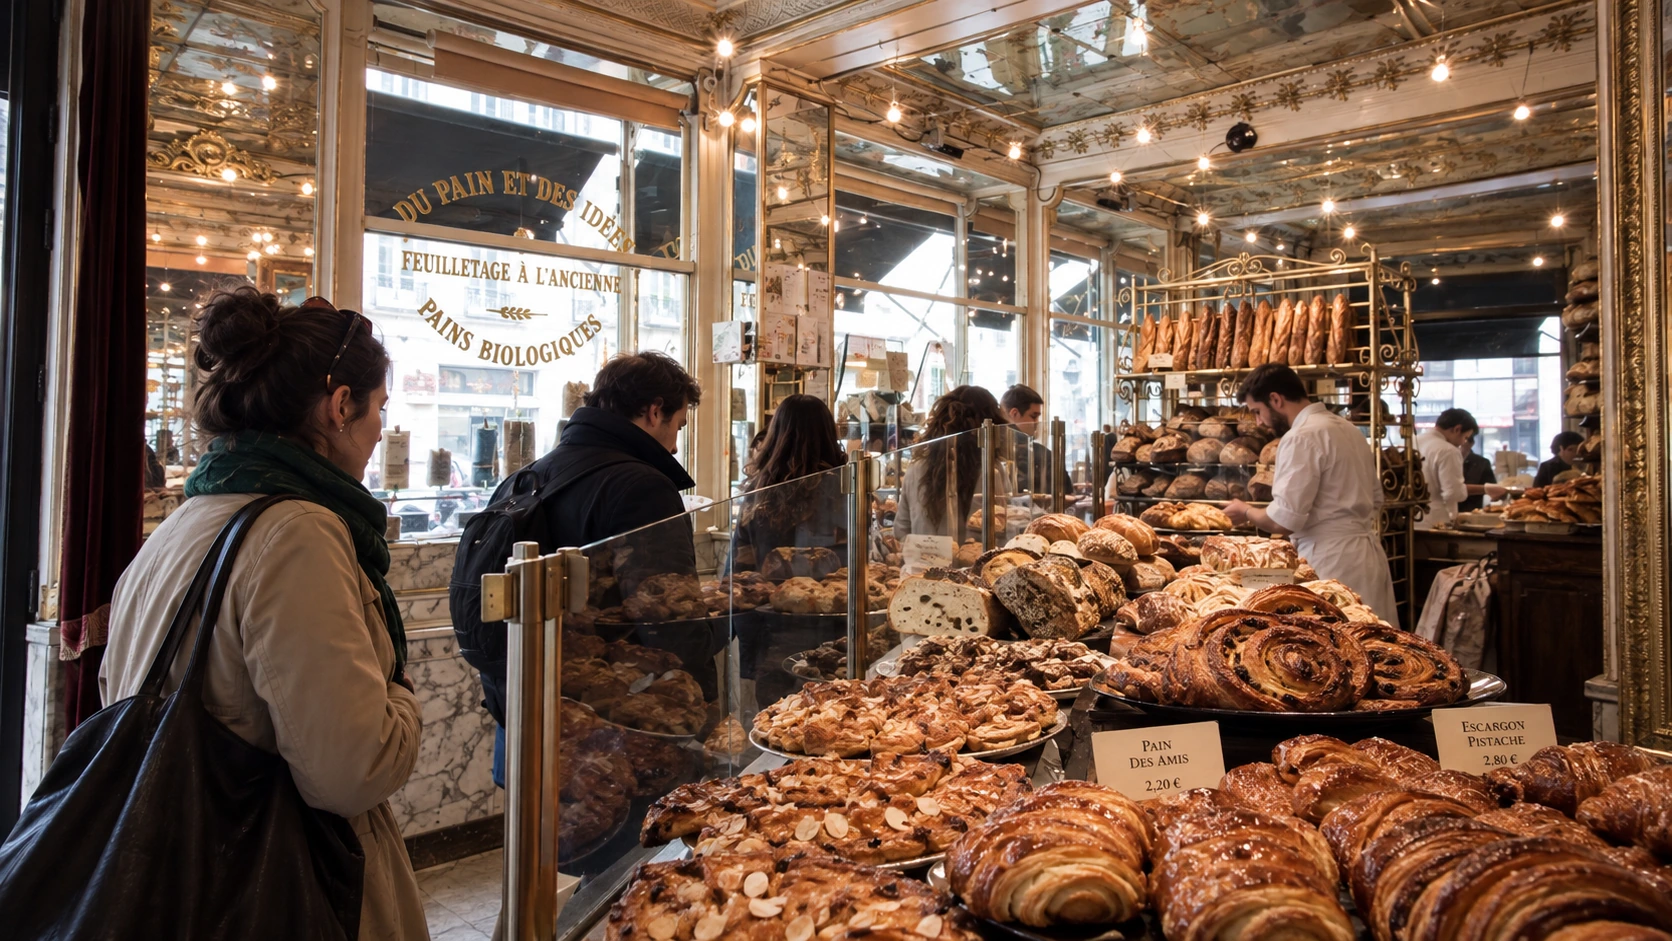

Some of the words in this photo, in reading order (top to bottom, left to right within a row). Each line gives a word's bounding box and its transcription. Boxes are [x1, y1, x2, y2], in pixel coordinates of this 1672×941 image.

[393, 188, 433, 223] DU
[432, 170, 494, 205] PAIN
[502, 170, 530, 196] ET
[535, 176, 577, 211] DES
[401, 250, 511, 282] FEUILLETAGE
[517, 260, 529, 284] À
[536, 266, 622, 294] L'ANCIENNE
[417, 297, 474, 351] PAINS
[478, 313, 602, 367] BIOLOGIQUES
[1141, 740, 1172, 752] PAIN
[1467, 735, 1526, 748] PISTACHE
[1129, 757, 1154, 769] DES
[1157, 754, 1189, 767] AMIS
[1483, 754, 1507, 766] 2,80
[1509, 754, 1518, 765] €
[1145, 779, 1171, 793] 2,20
[1173, 777, 1182, 789] €
